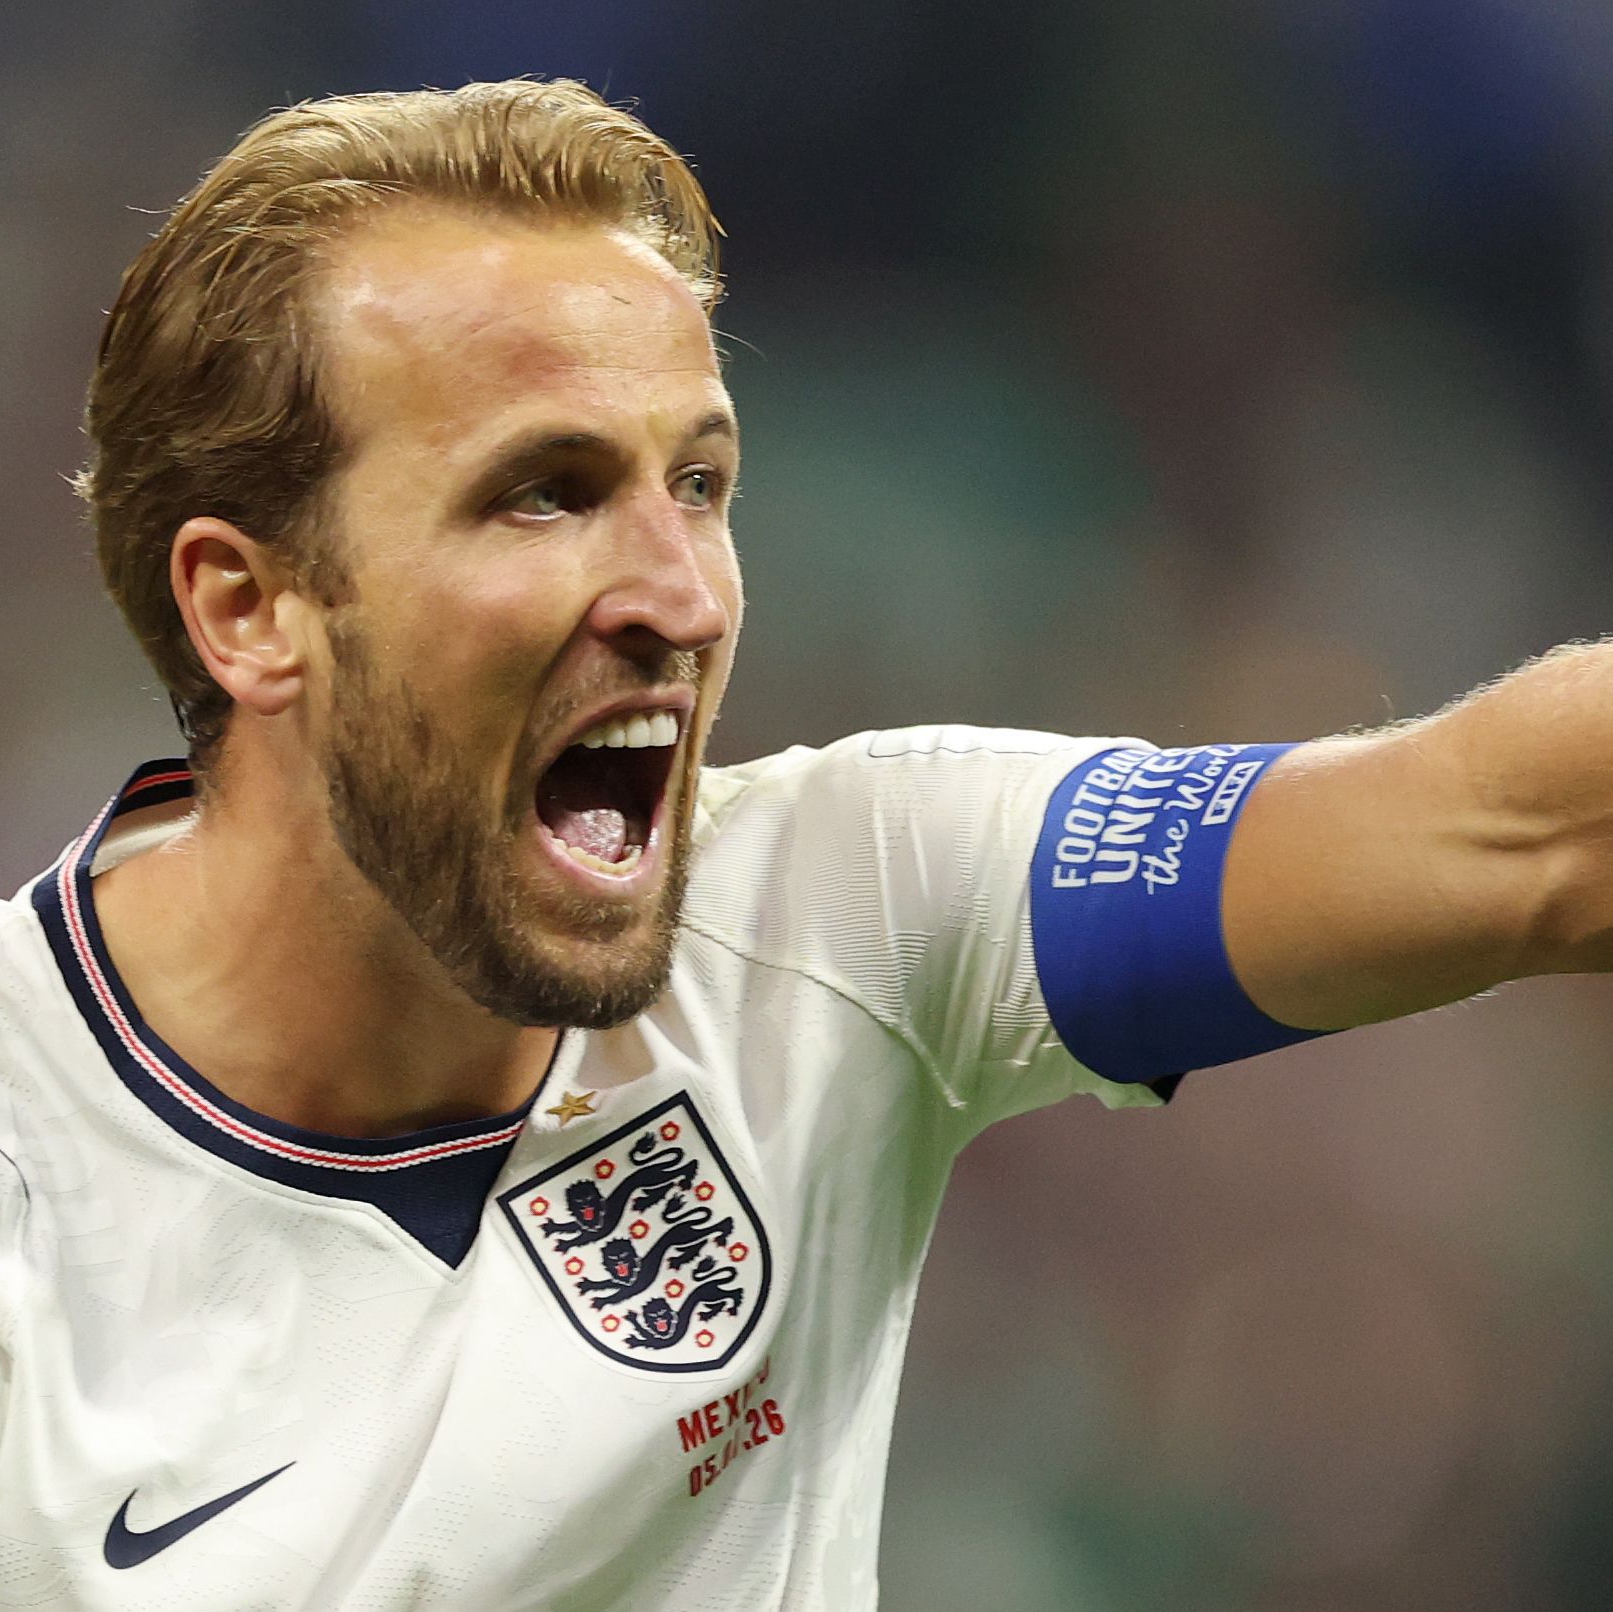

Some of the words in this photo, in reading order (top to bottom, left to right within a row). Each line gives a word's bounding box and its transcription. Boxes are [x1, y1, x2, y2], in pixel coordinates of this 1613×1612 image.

[1052, 749, 1152, 888] FOOTBALL
[1206, 763, 1260, 820] FIFA
[1142, 818, 1190, 895] the
